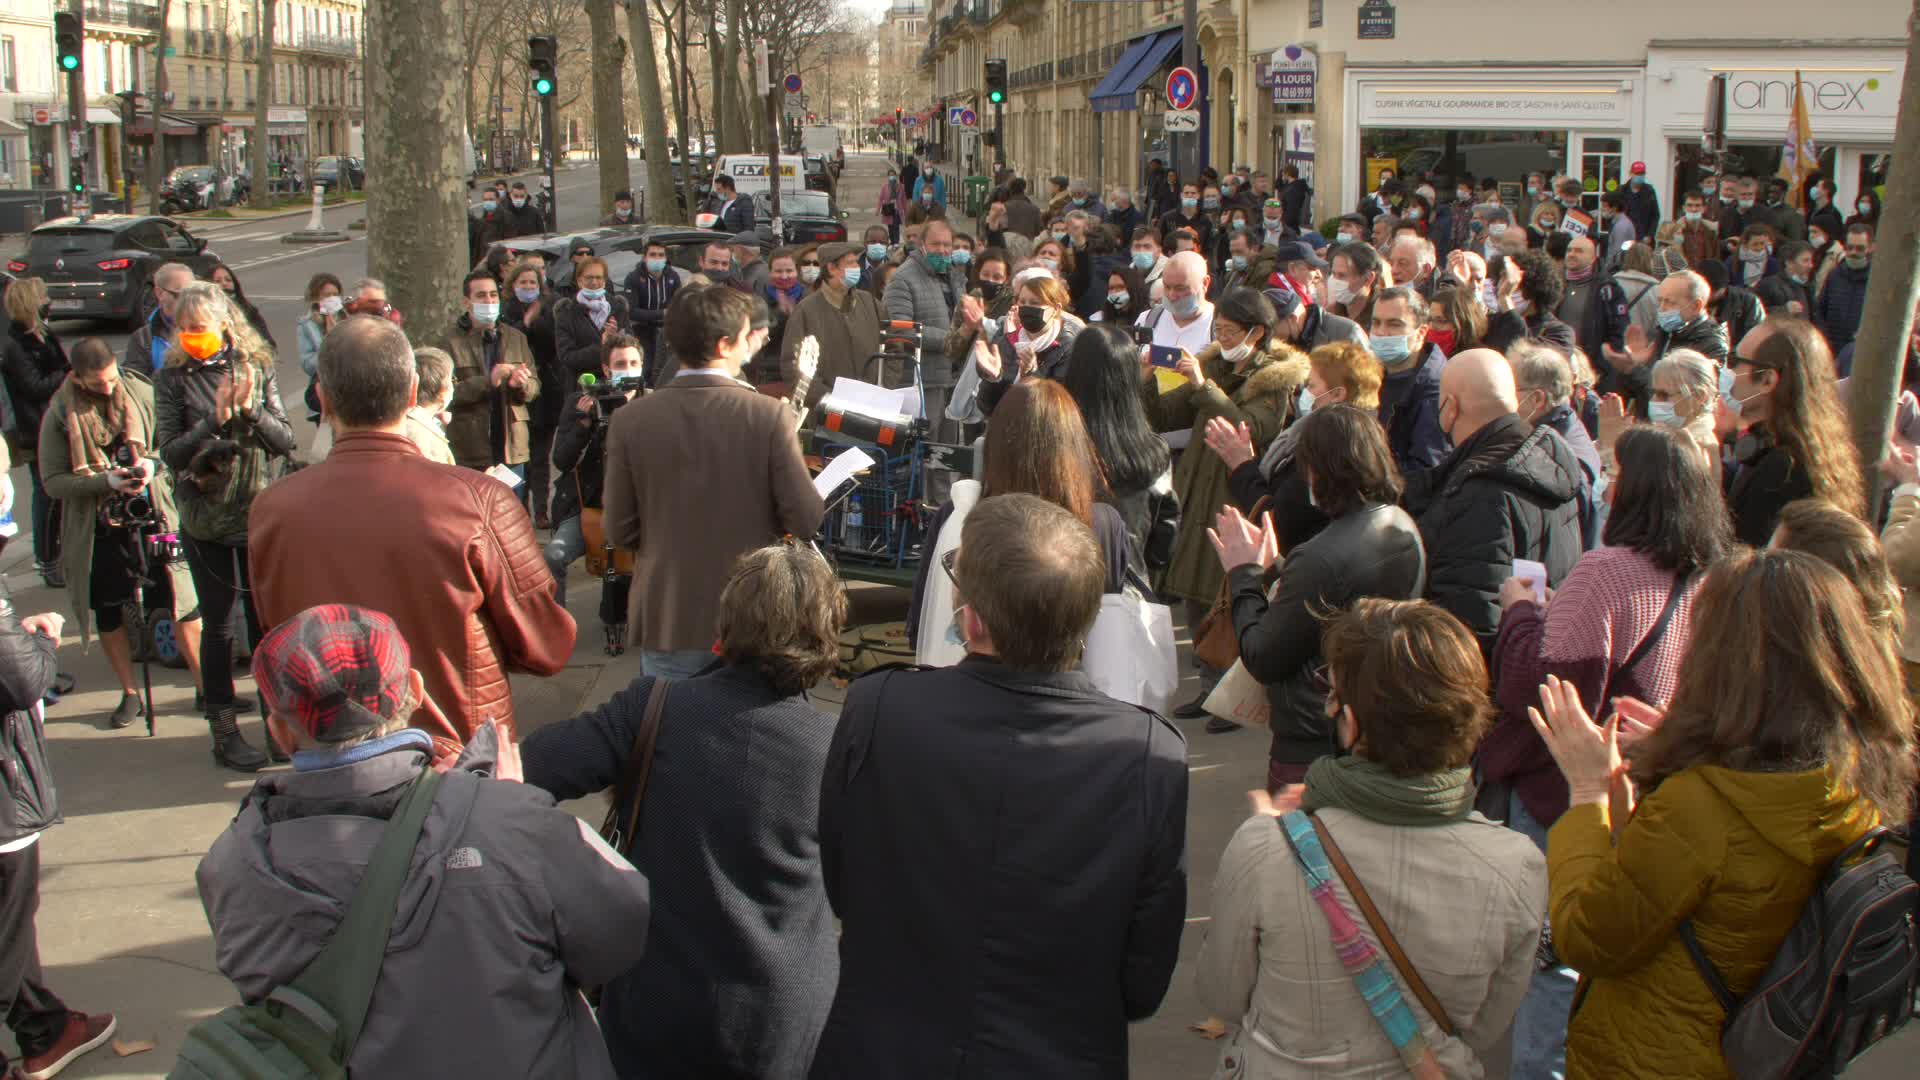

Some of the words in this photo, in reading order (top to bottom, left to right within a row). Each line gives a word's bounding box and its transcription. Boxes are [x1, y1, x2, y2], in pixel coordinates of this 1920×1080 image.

[1274, 75, 1281, 84] A
[1283, 75, 1312, 84] LOUER
[1274, 87, 1281, 98] 01
[1376, 100, 1403, 108] CUISINE
[735, 165, 762, 175] FLY
